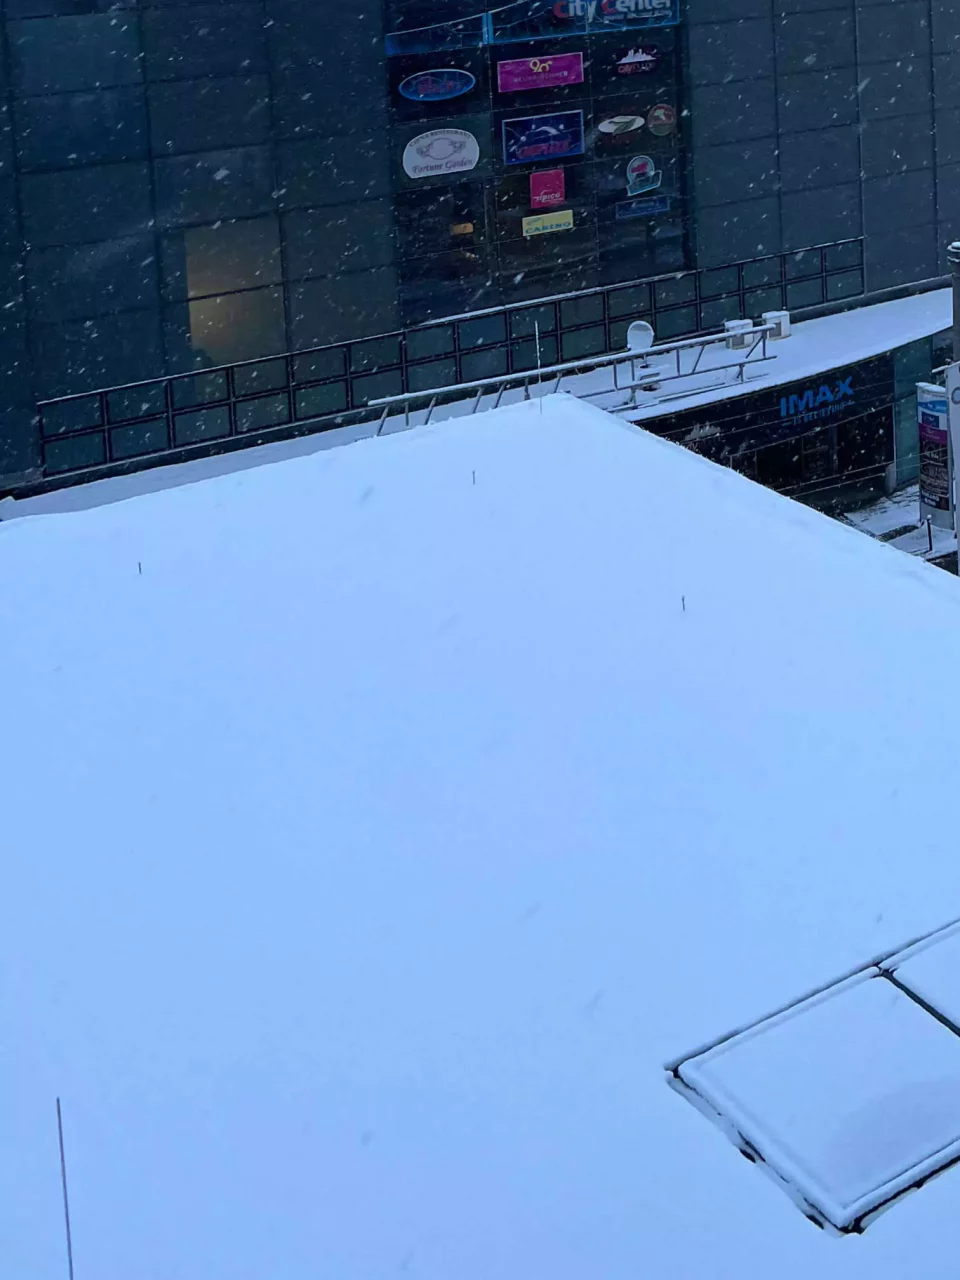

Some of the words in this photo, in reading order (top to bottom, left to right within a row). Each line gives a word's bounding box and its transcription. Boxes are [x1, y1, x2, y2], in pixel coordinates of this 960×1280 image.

[412, 161, 443, 175] Fortune
[445, 156, 473, 171] Garden
[779, 375, 855, 418] IMAX
